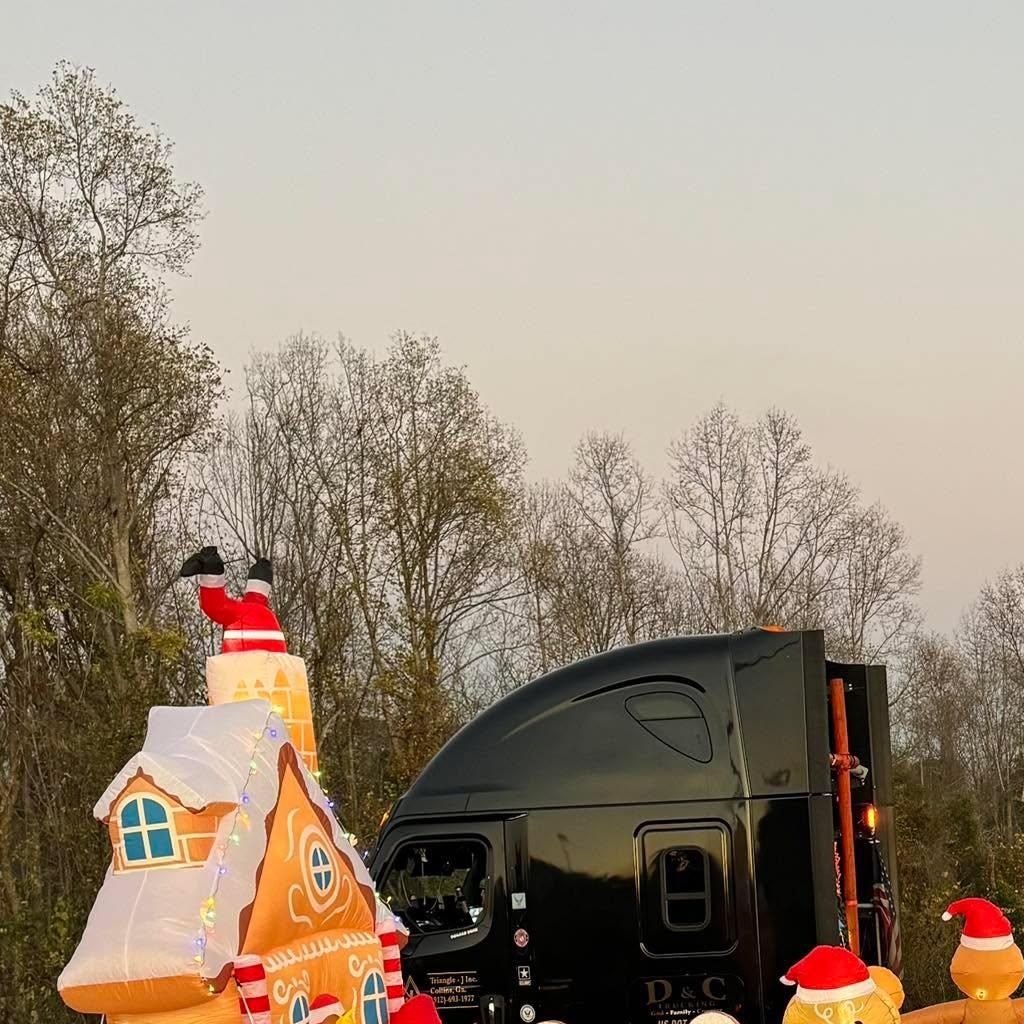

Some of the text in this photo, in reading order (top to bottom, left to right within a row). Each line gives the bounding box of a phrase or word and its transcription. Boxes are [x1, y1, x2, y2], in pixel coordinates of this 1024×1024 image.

[429, 976, 456, 985] Triangle
[465, 975, 479, 983] Inc.
[644, 976, 727, 1005] D & C
[433, 994, 475, 1004] 912)-693-1977
[669, 1008, 692, 1017] Family
